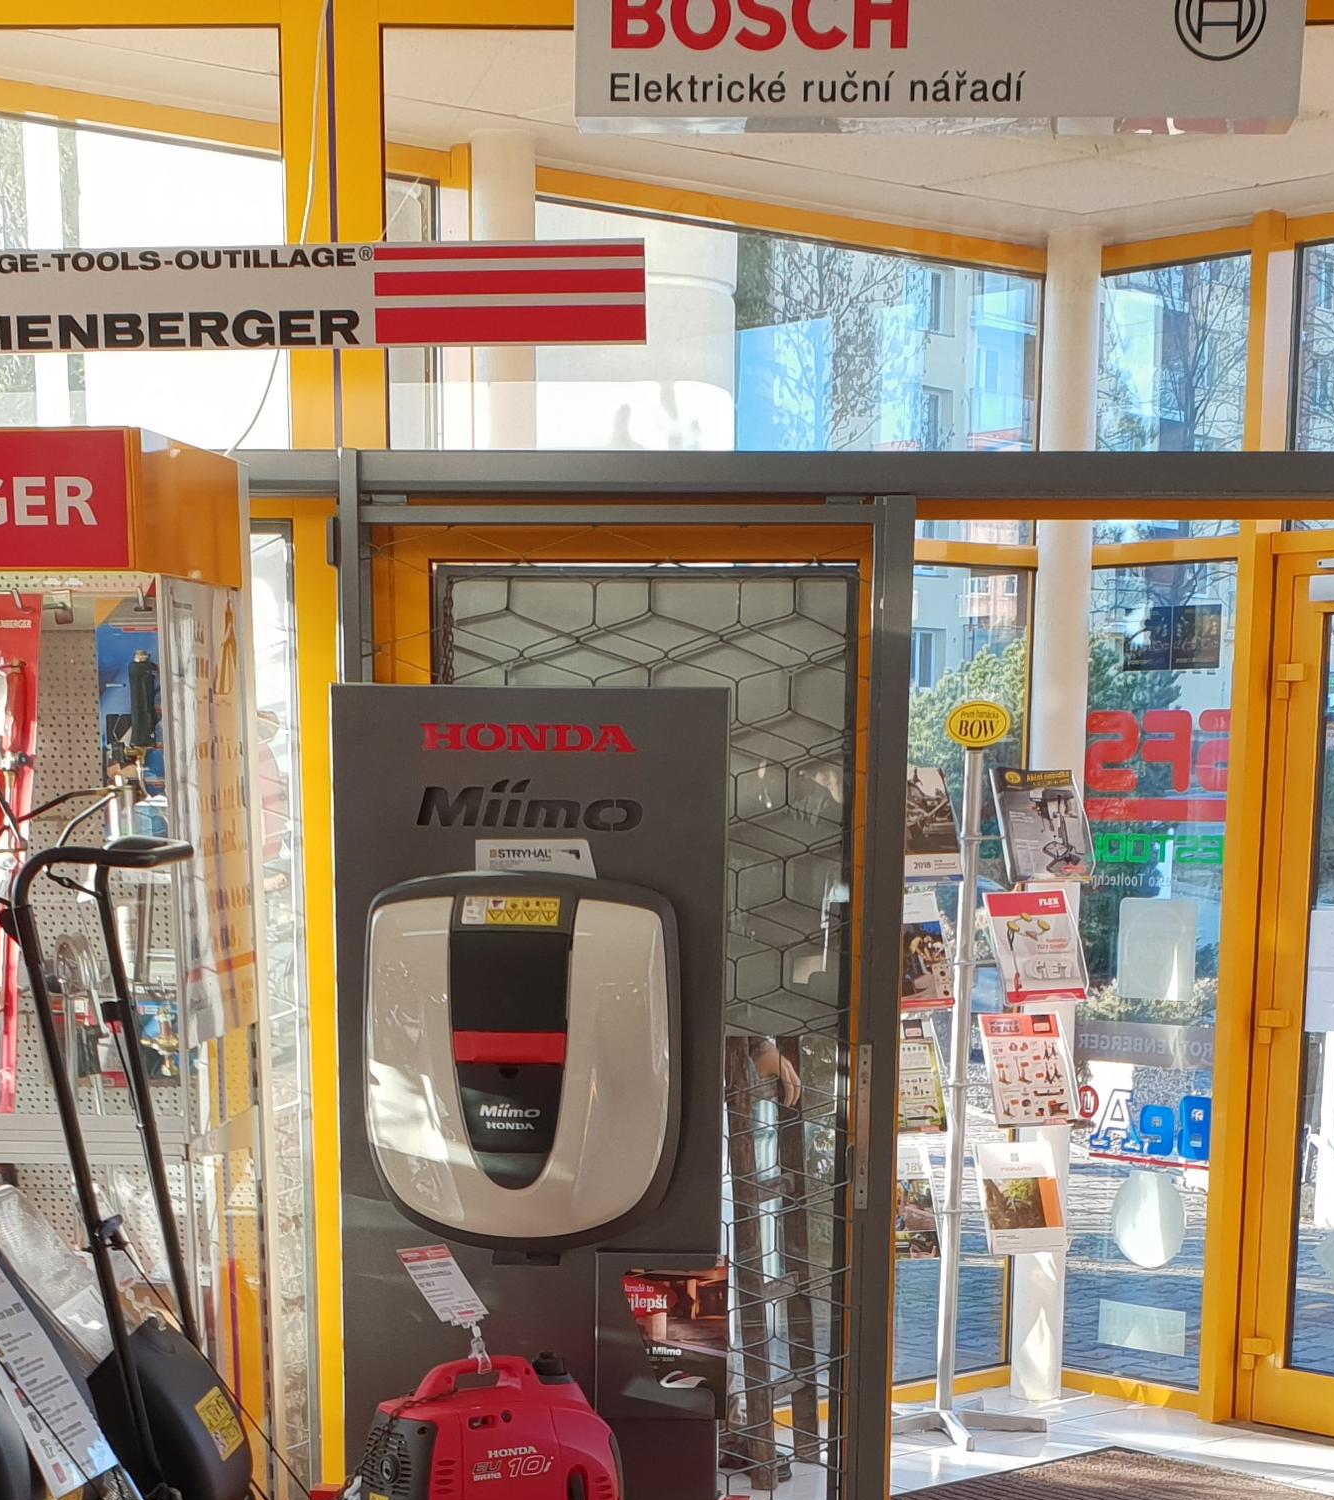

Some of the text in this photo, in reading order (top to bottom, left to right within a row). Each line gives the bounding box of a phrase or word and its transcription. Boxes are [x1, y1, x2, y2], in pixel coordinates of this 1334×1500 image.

[610, 0, 909, 51] BOSCH
[609, 71, 1027, 104] Elektrické ruční nářadí
[958, 719, 999, 739] BOW
[421, 723, 638, 753] HONDA
[416, 778, 644, 832] Miimo
[498, 848, 551, 859] STRYHAL
[1039, 896, 1059, 907] FLEX
[989, 1025, 1021, 1035] DEALS
[478, 1103, 541, 1120] Miimo
[485, 1121, 535, 1132] HONDA
[487, 1445, 537, 1459] HONDA
